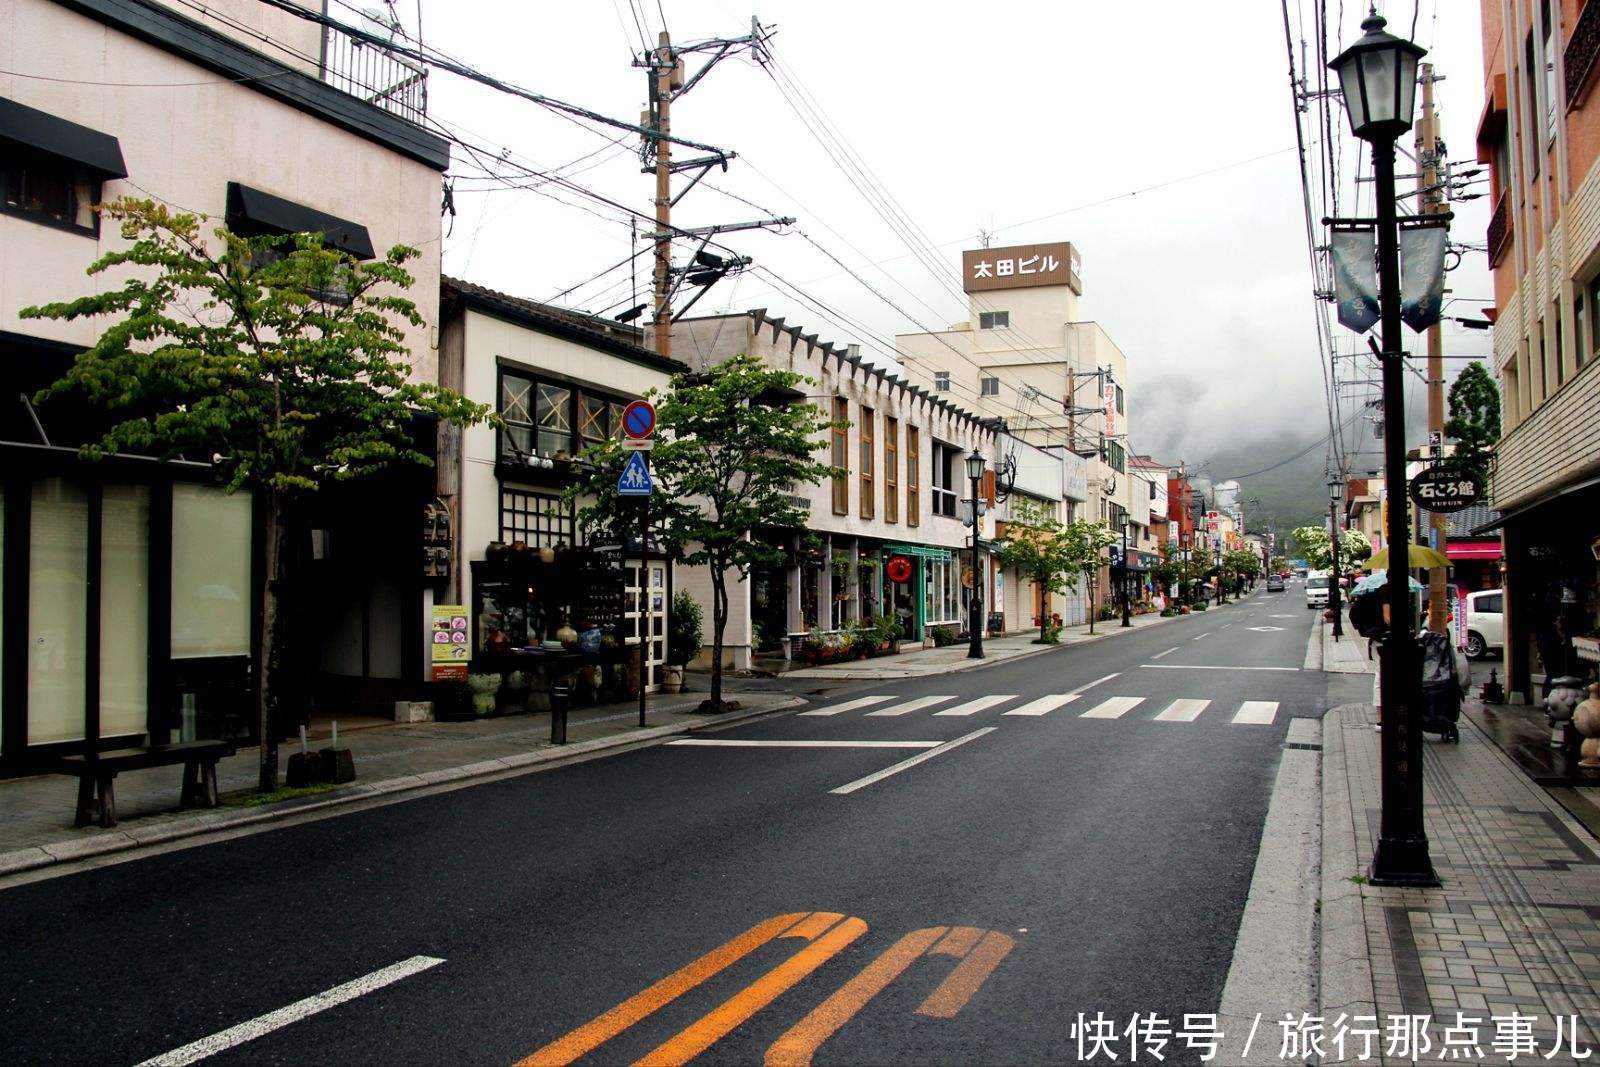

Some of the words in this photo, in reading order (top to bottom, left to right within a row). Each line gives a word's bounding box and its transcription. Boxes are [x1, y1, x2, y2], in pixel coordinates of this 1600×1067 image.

[974, 254, 1060, 279] 太田ビル
[1418, 480, 1475, 498] 石ころ館
